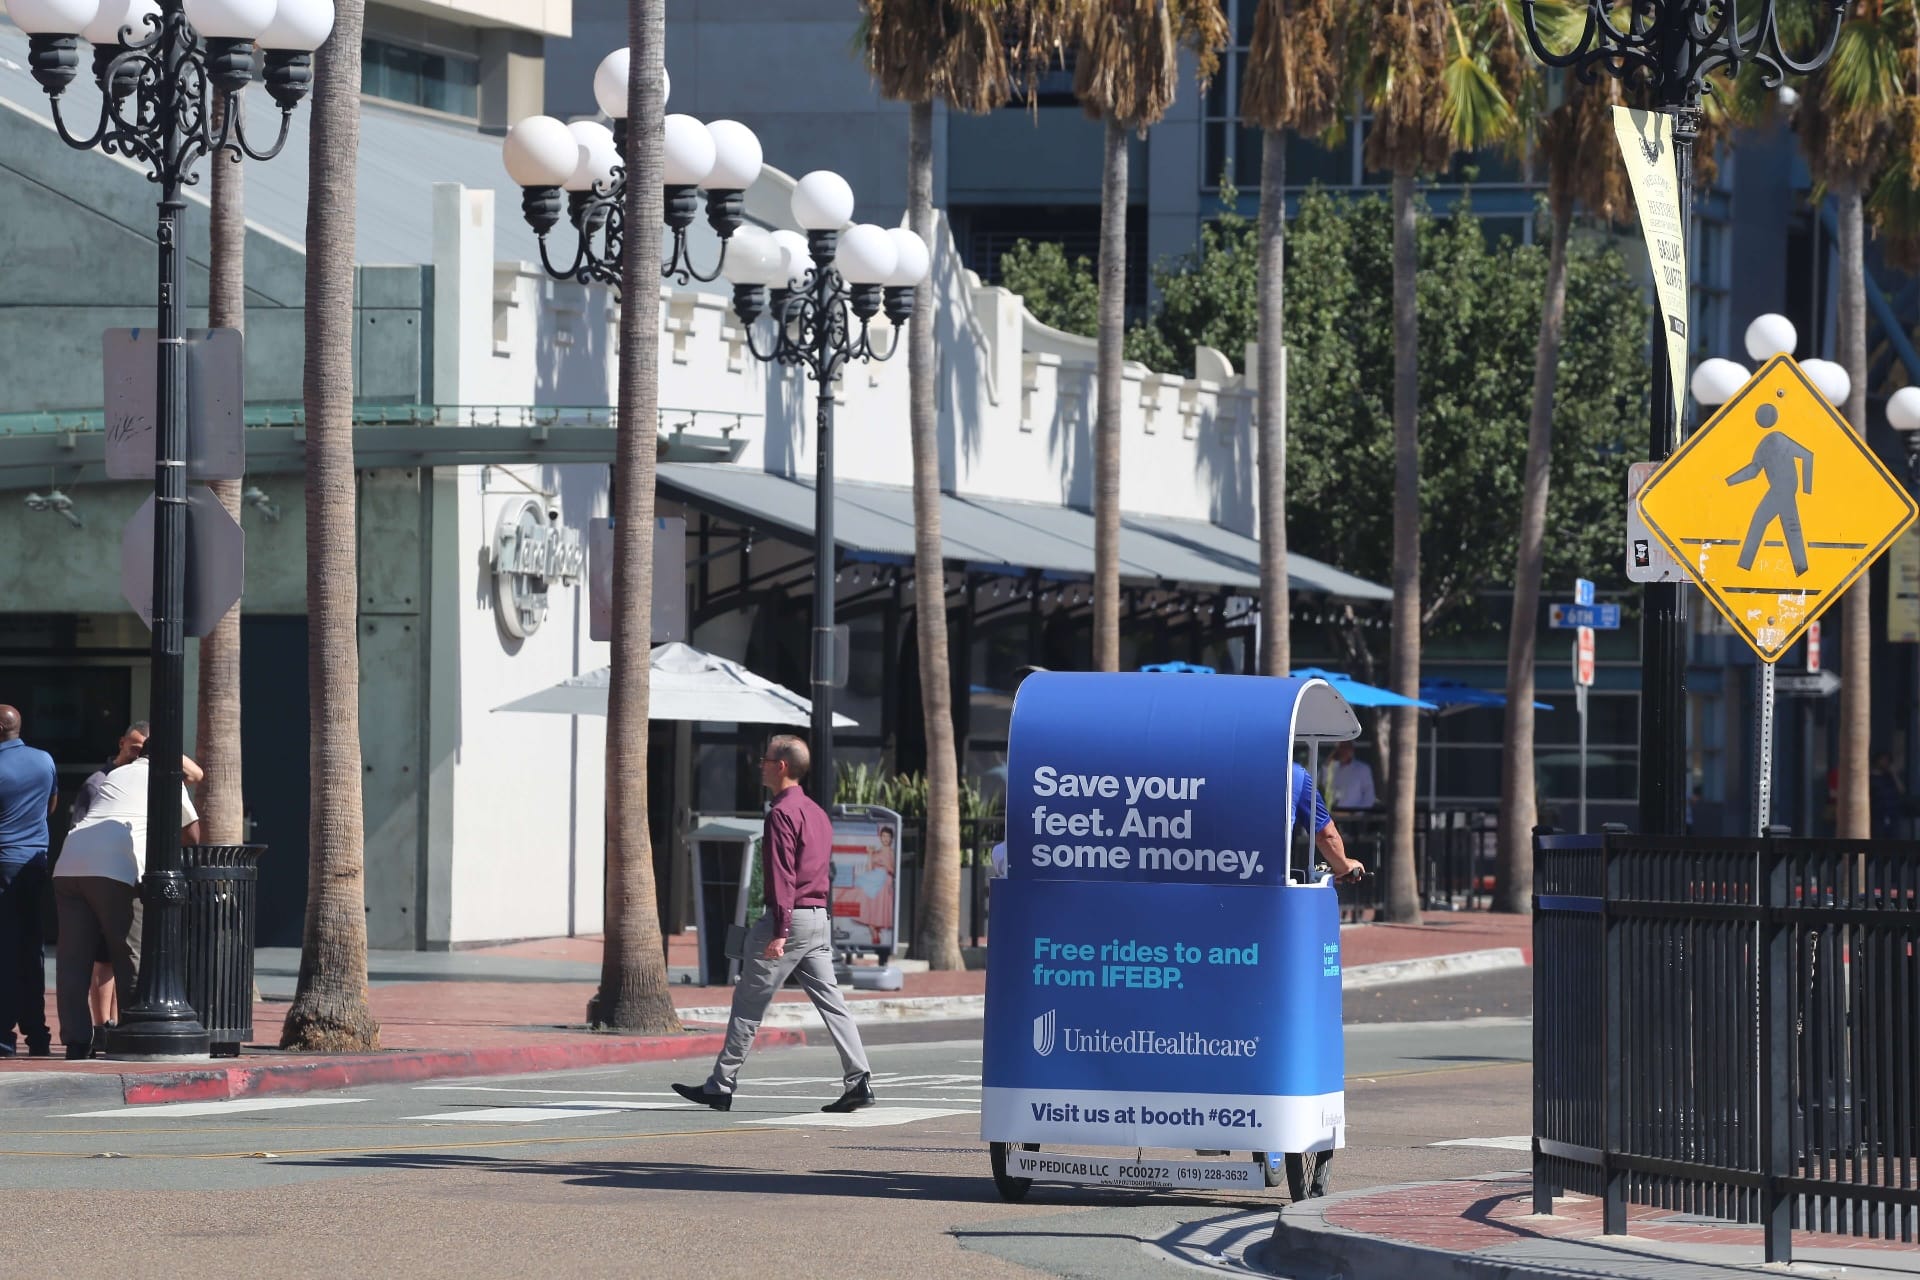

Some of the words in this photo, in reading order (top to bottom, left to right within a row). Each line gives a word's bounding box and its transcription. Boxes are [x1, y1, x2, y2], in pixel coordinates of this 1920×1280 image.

[1033, 766, 1119, 798] Save
[1125, 776, 1205, 805] your
[1032, 805, 1114, 837] feet.
[1119, 807, 1192, 839] And
[1032, 844, 1131, 869] some
[1138, 847, 1264, 880] money.
[1034, 937, 1095, 961] Free
[1101, 938, 1168, 963] rides
[1174, 942, 1202, 964] to
[1208, 943, 1259, 966] and
[1033, 964, 1095, 987] from
[1102, 965, 1184, 990] IFEBP.
[1031, 1102, 1080, 1123] Visit
[1084, 1108, 1110, 1124] us
[1114, 1106, 1136, 1125] at
[1141, 1105, 1205, 1127] booth
[1208, 1108, 1263, 1128] #621.
[1019, 1158, 1037, 1171] VIP
[1039, 1160, 1087, 1175] PEDICAB
[1089, 1164, 1109, 1176] LLC
[1119, 1166, 1169, 1178] PC00272
[1177, 1167, 1202, 1180] (619)
[1204, 1168, 1249, 1181] 228-3632
